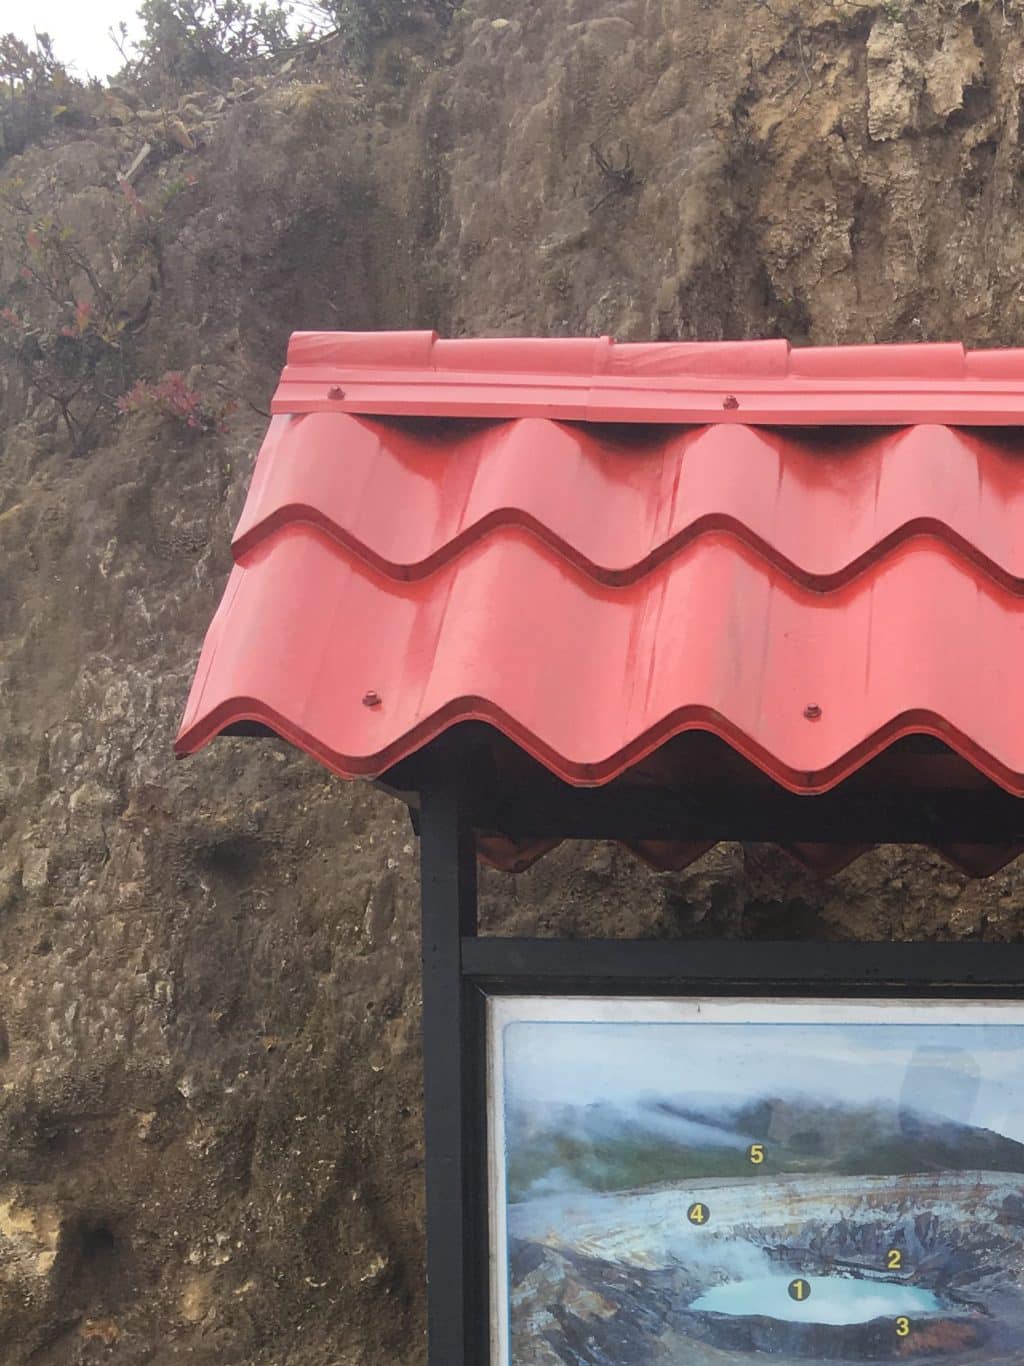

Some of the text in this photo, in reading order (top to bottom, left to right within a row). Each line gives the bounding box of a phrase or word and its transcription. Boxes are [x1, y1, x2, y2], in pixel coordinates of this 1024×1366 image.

[751, 1145, 764, 1163] 5
[691, 1205, 704, 1223] 4
[887, 1250, 901, 1269] 2
[794, 1280, 804, 1299] 1
[896, 1317, 910, 1336] 3
